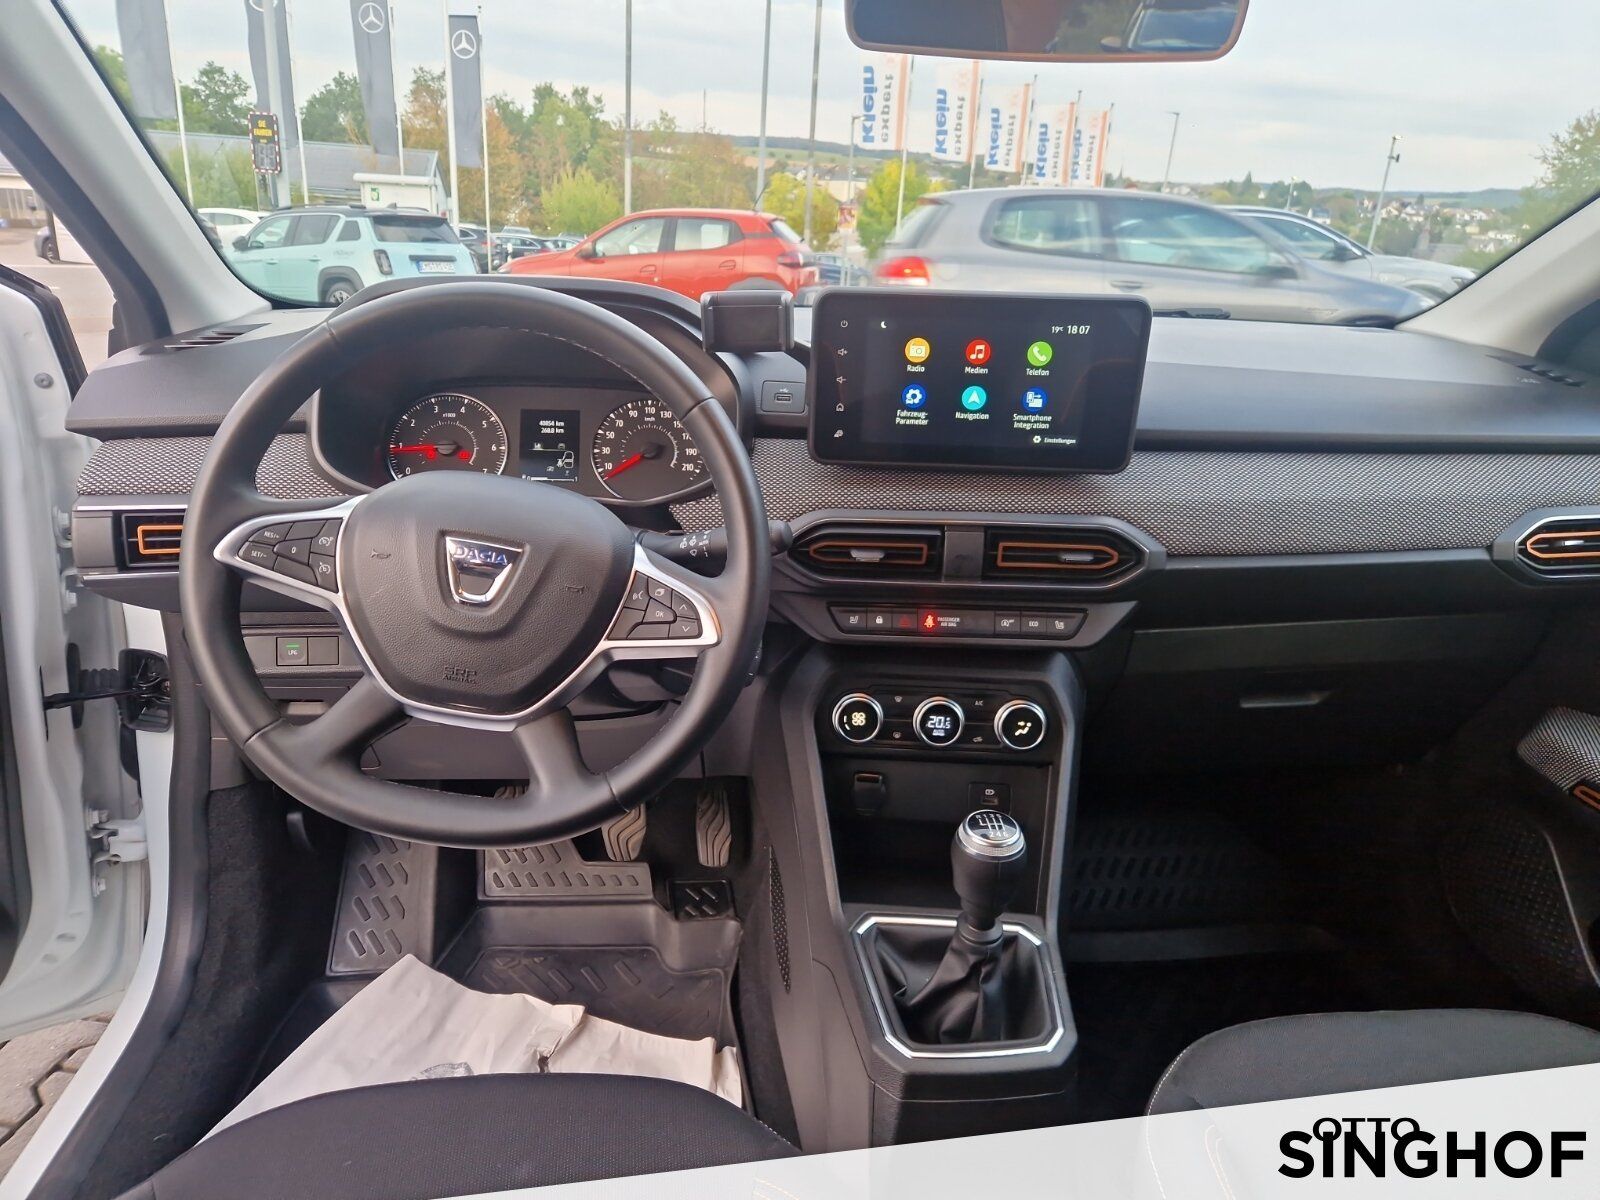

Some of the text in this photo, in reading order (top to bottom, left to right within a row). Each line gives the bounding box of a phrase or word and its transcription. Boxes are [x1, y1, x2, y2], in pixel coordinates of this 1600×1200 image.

[907, 364, 925, 372] Radio
[964, 366, 988, 374] Medien
[1026, 368, 1050, 376] Telefon
[660, 410, 672, 418] 130
[896, 410, 928, 418] Fahrzeug-
[956, 412, 990, 420] Navigation
[1013, 414, 1052, 423] Smartphone
[1014, 422, 1050, 430] Integration
[686, 448, 698, 456] 190
[406, 466, 410, 474] 0
[682, 463, 694, 471] 210
[454, 545, 508, 565] DACIA
[926, 716, 950, 728] 20.5
